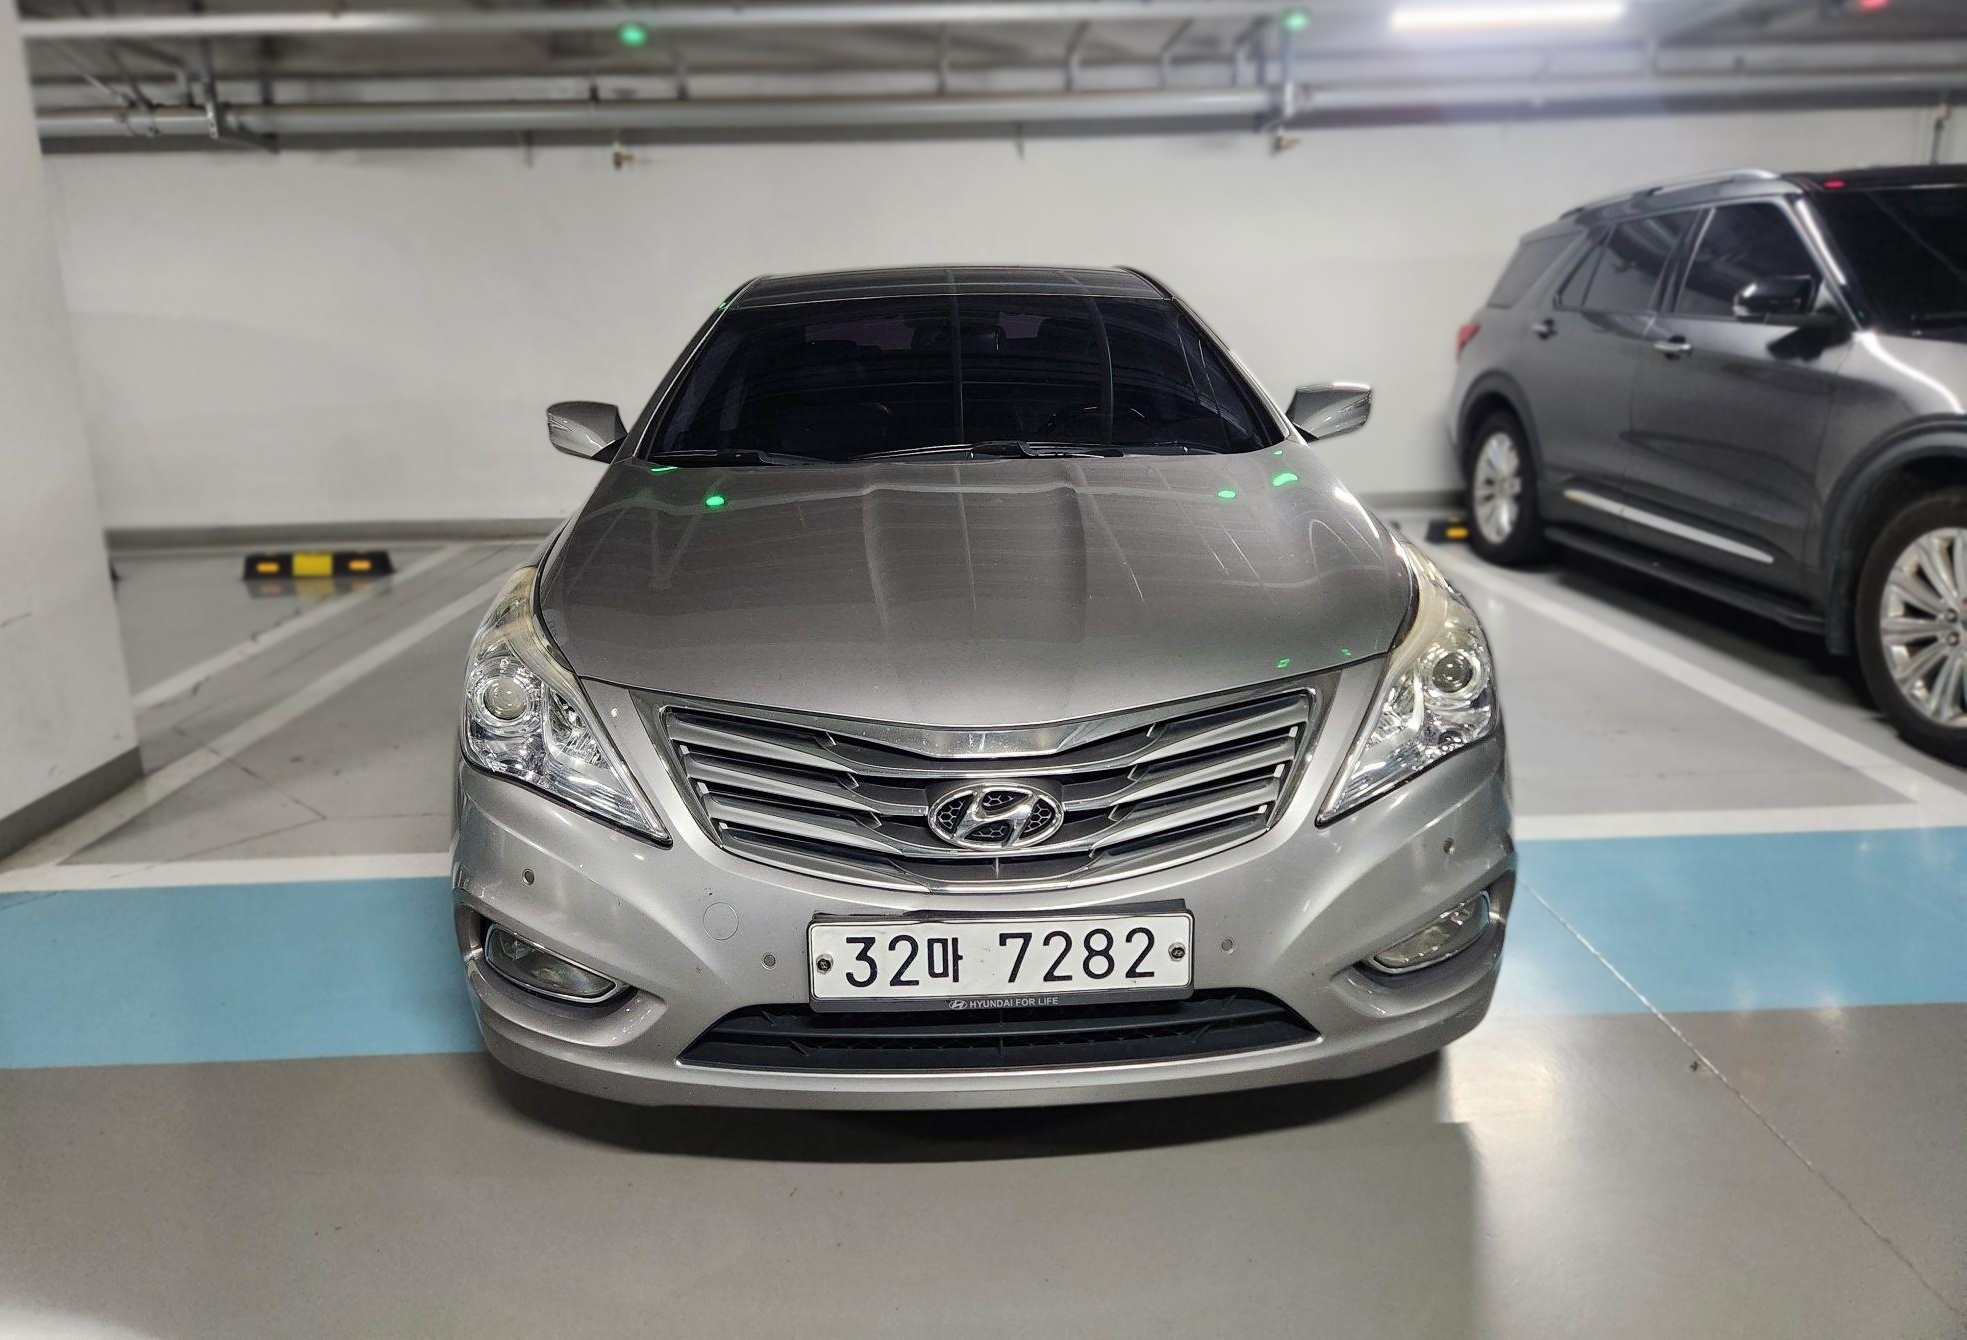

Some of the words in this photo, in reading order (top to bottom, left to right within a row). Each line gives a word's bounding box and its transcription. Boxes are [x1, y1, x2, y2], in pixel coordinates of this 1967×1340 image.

[845, 934, 963, 987] 32마
[999, 927, 1155, 983] 7282
[969, 999, 1013, 1009] HYUNDAI
[1015, 998, 1036, 1007] FOR
[1038, 996, 1059, 1006] LIFE
